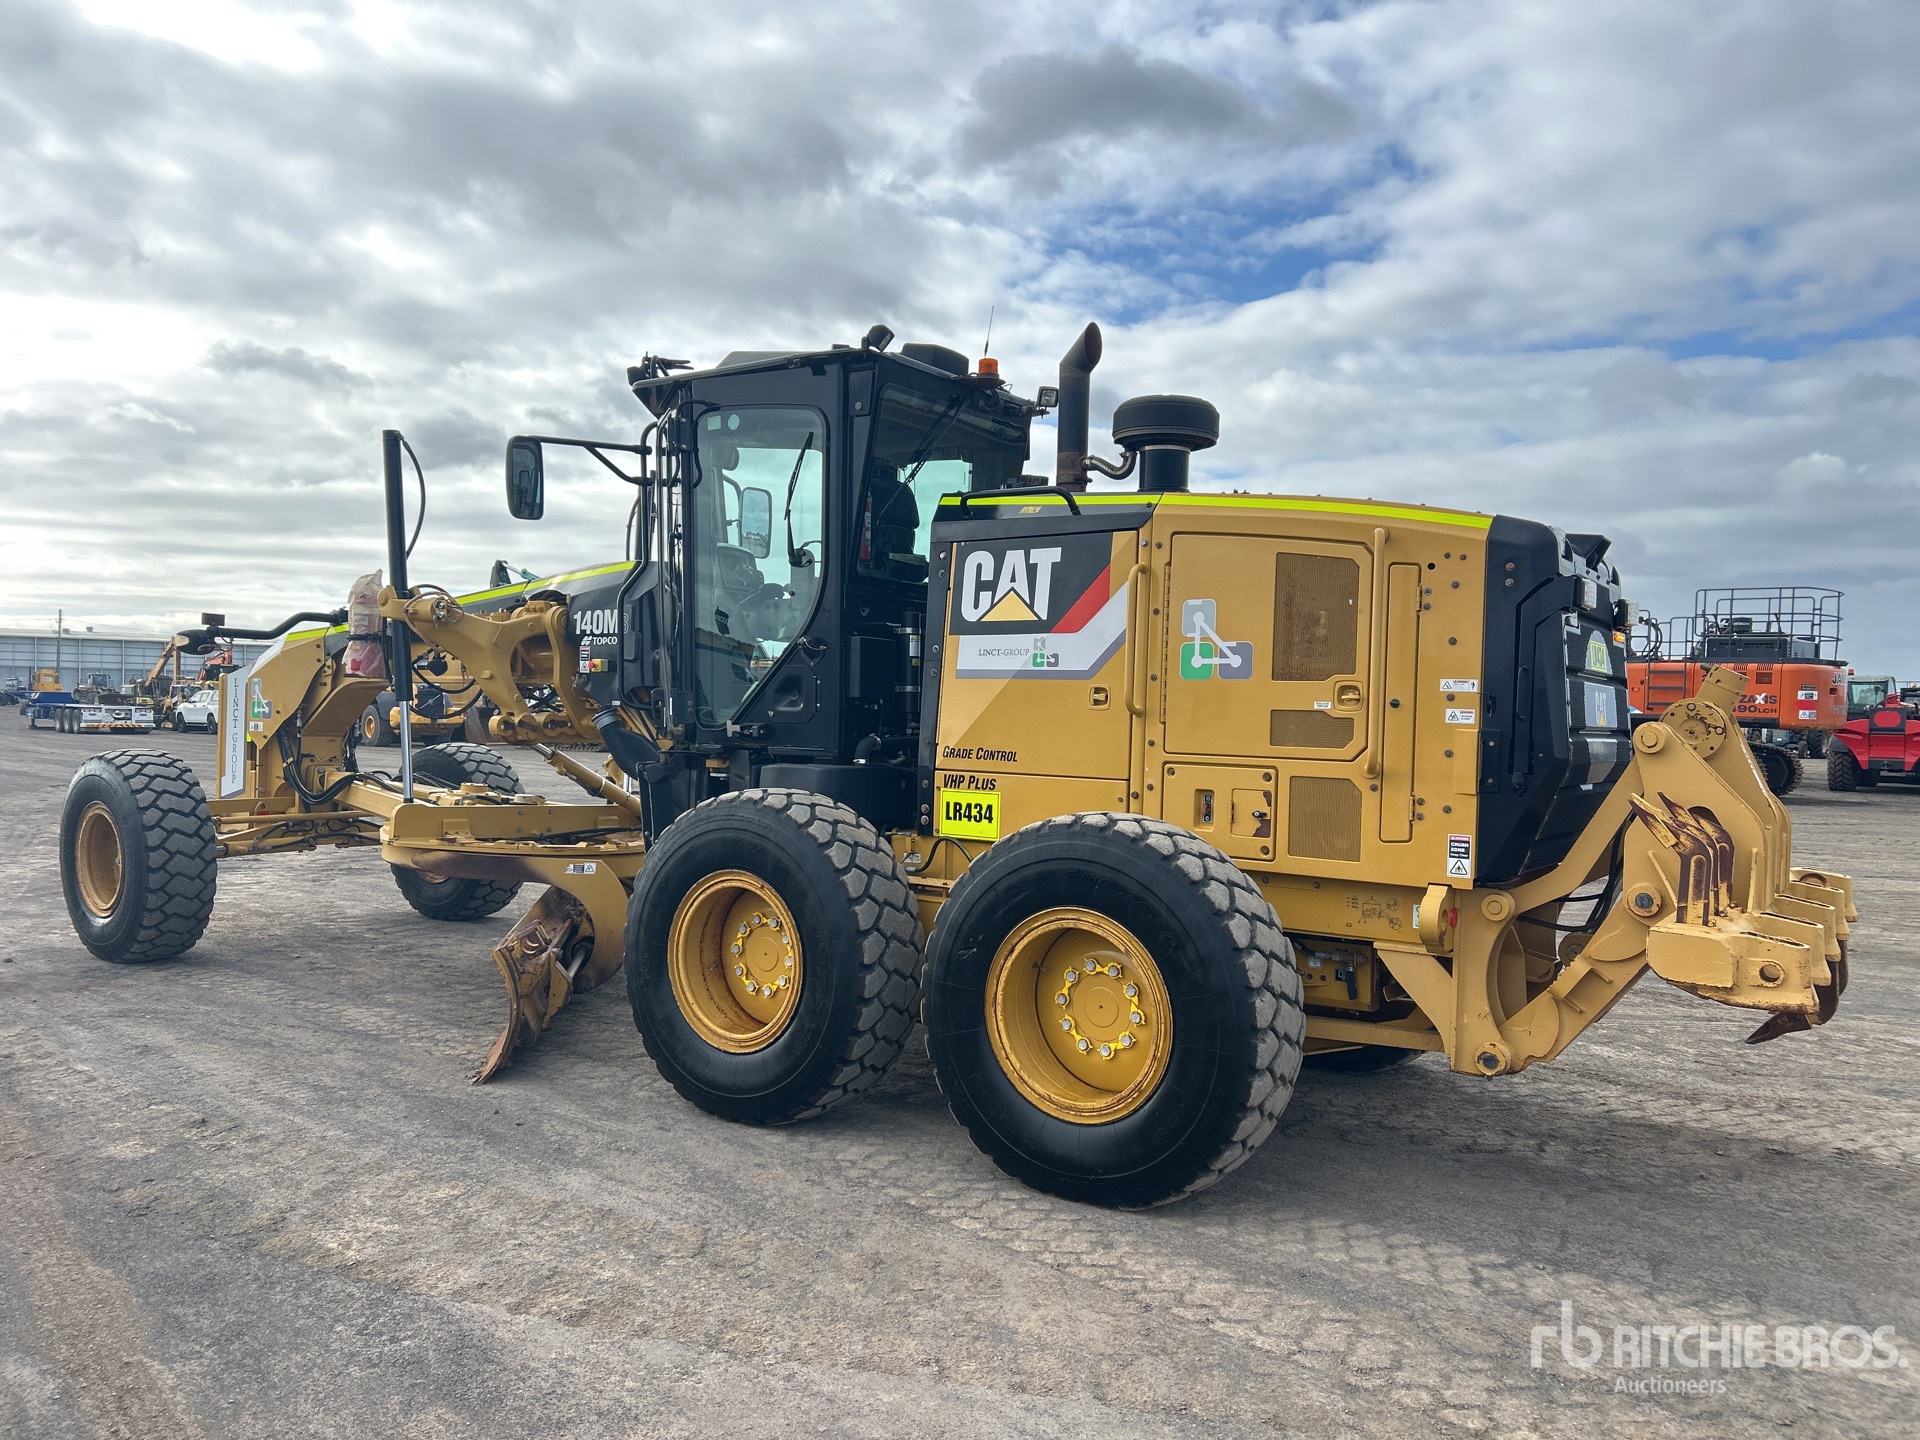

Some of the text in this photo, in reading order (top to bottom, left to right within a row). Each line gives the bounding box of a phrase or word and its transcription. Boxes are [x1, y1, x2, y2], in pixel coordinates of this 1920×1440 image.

[961, 546, 1062, 622] CAT
[592, 637, 618, 645] TOPCO
[978, 647, 1030, 658] LINCT-GROUP
[1739, 693, 1777, 704] ZAXIS
[1594, 690, 1607, 726] CAT
[1732, 705, 1777, 714] 90LCH
[942, 746, 1018, 763] GRADE CONTROL
[943, 774, 996, 791] VHP PLUS
[945, 801, 994, 824] LR434
